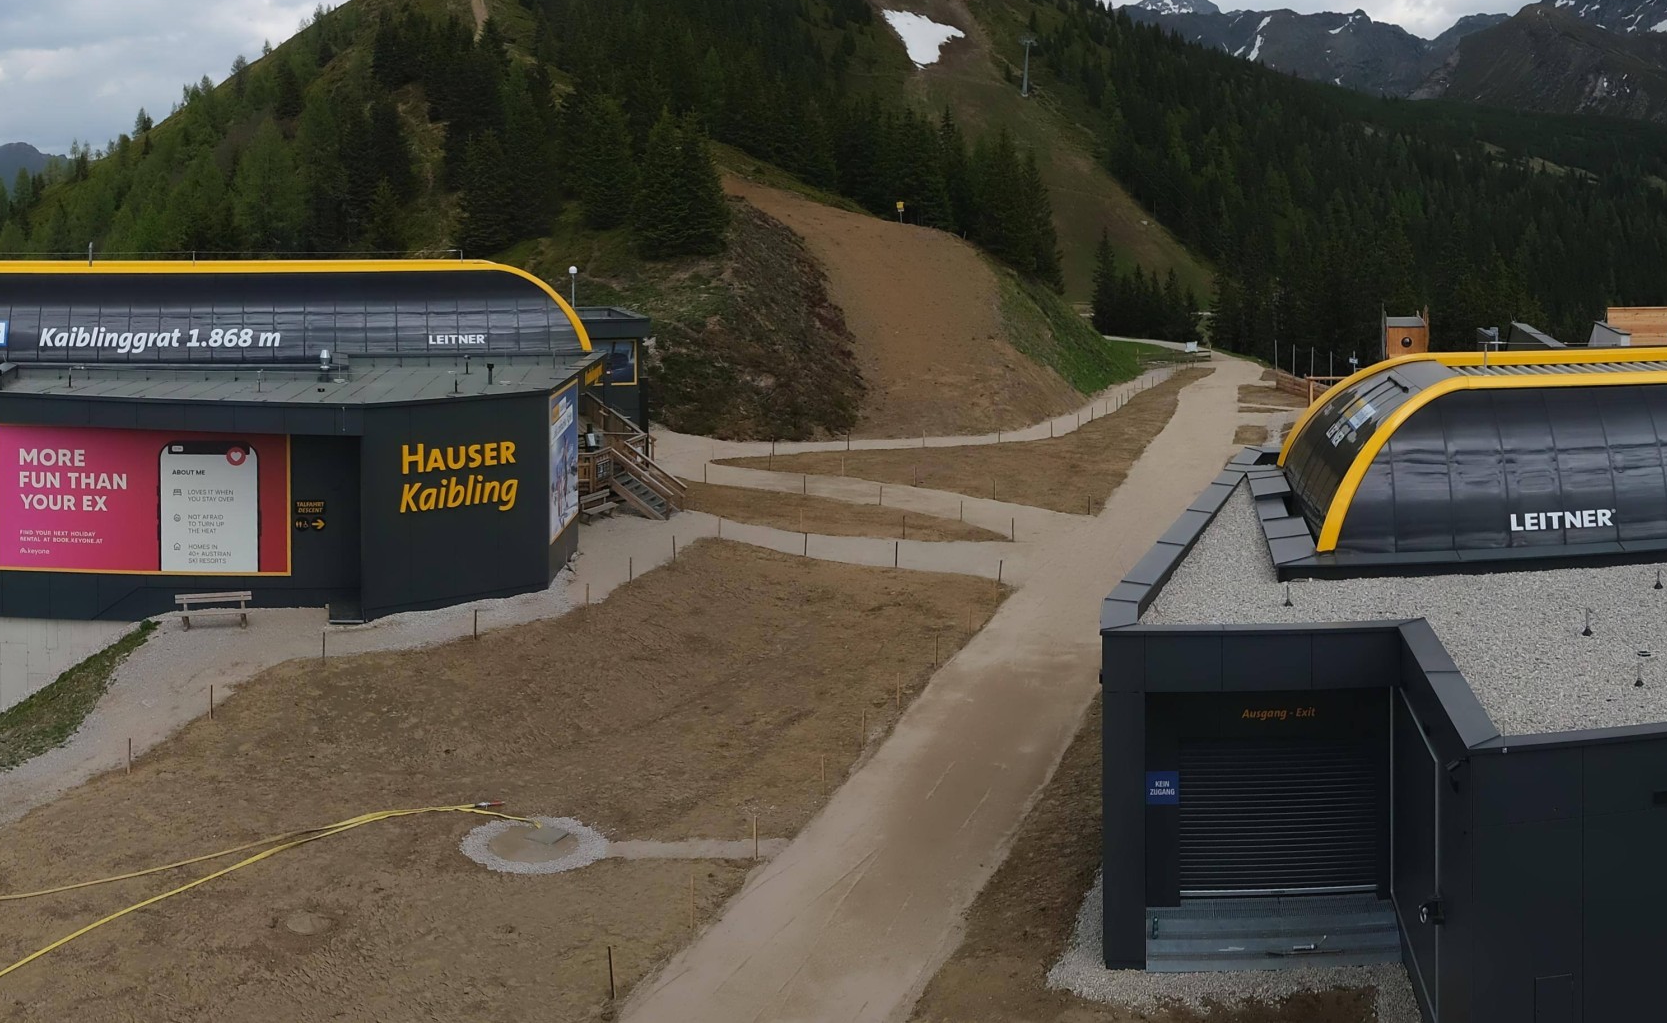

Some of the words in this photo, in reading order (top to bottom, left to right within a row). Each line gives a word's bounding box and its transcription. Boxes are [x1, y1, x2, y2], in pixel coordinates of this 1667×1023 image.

[39, 326, 181, 354] Kaiblinggrat
[186, 327, 254, 348] 1.868
[258, 331, 281, 348] m
[19, 448, 86, 467] MORE
[401, 440, 517, 475] HAUSER
[19, 471, 61, 489] FUN
[67, 472, 128, 490] THAN
[20, 493, 77, 511] YOUR
[82, 495, 108, 512] EX
[399, 474, 519, 514] Kaibling
[1241, 708, 1288, 721] Ausgang
[1295, 706, 1316, 718] Exit
[1149, 788, 1176, 796] ZUGANG
[1155, 780, 1170, 788] KEIN
